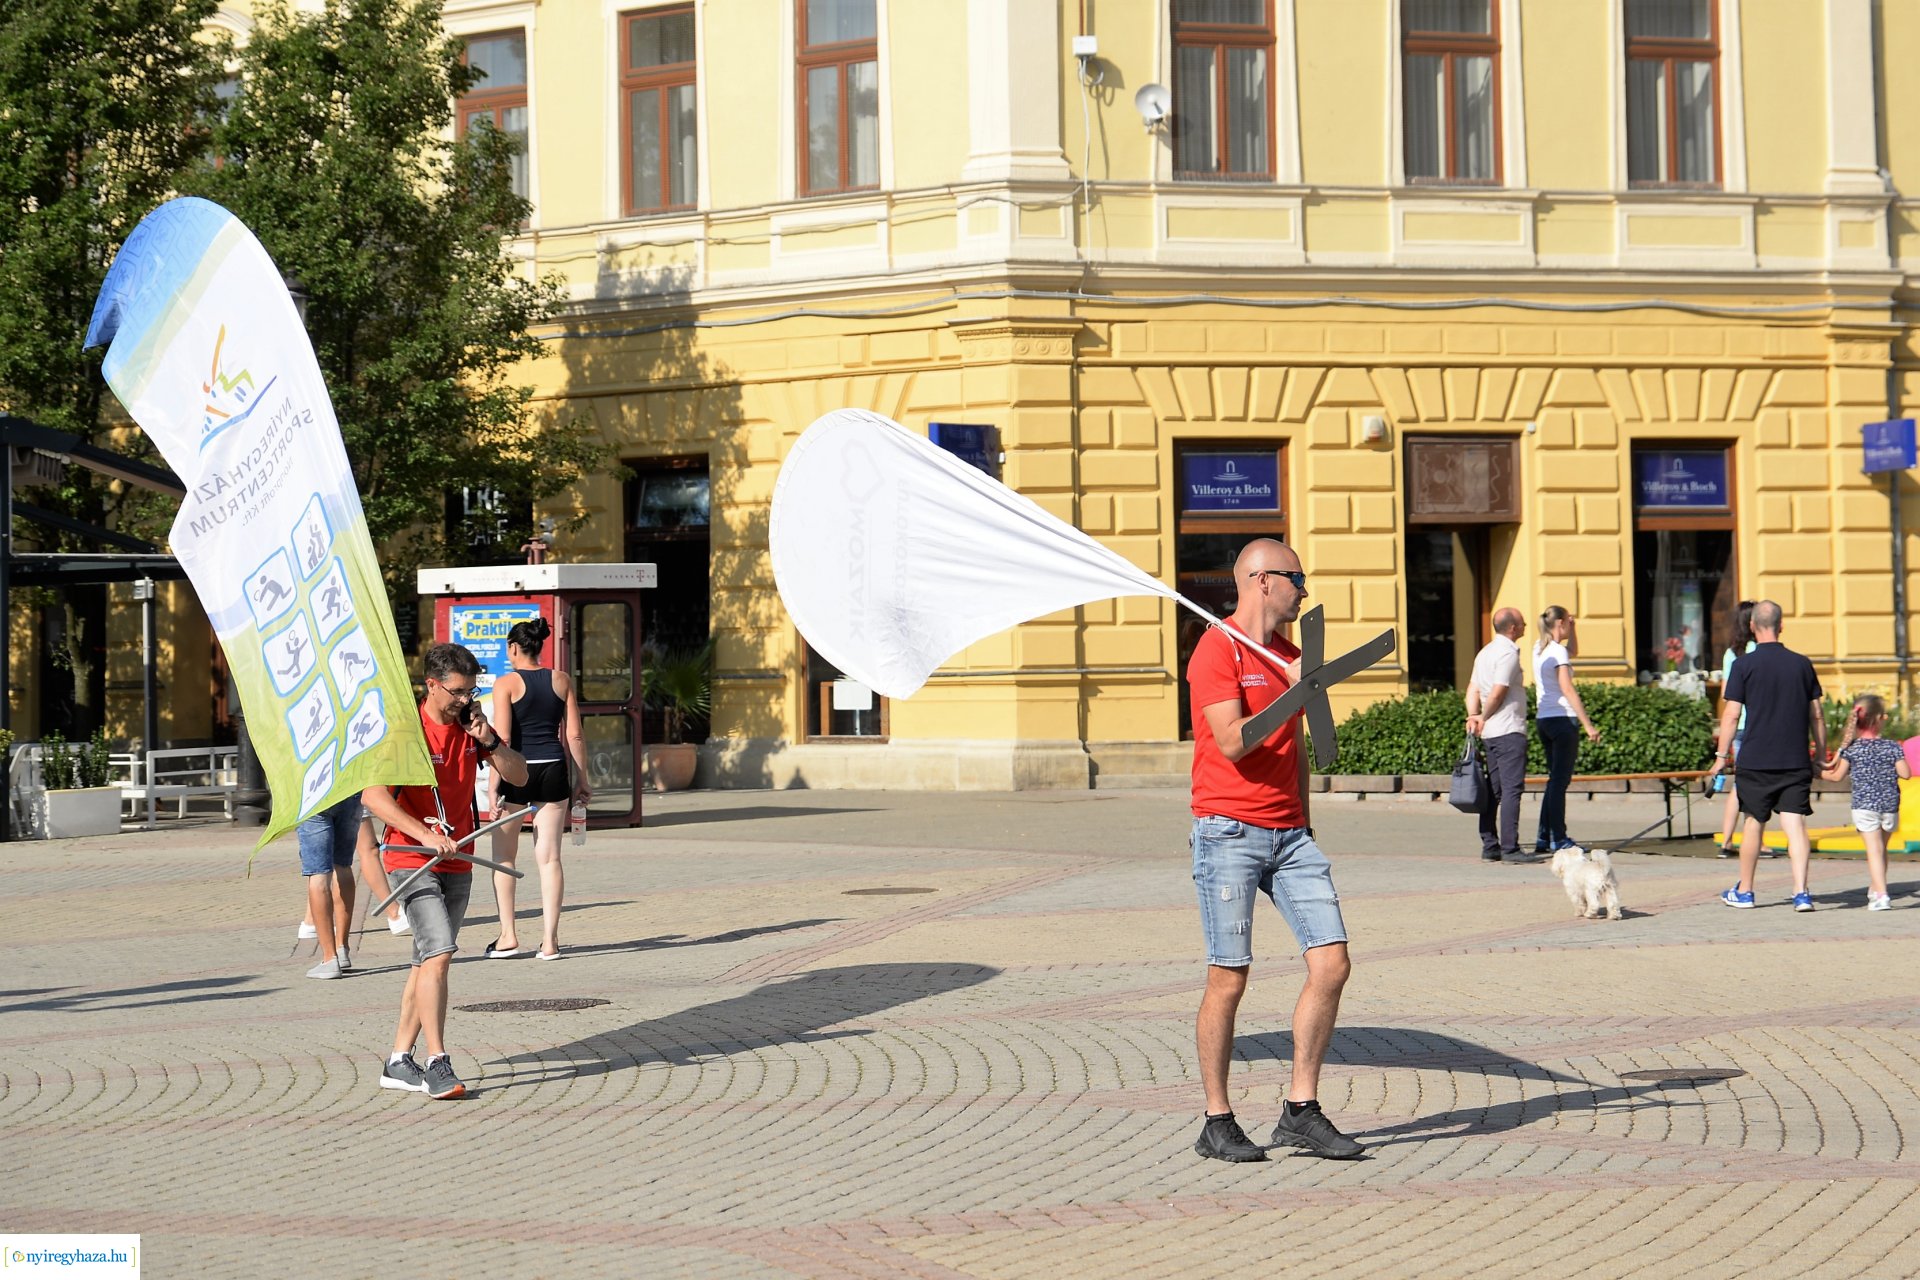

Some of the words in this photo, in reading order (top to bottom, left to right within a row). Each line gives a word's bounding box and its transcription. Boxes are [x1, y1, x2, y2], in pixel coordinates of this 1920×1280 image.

[1191, 484, 1233, 497] Villeroy
[1235, 486, 1242, 494] &
[1244, 484, 1271, 494] Boch
